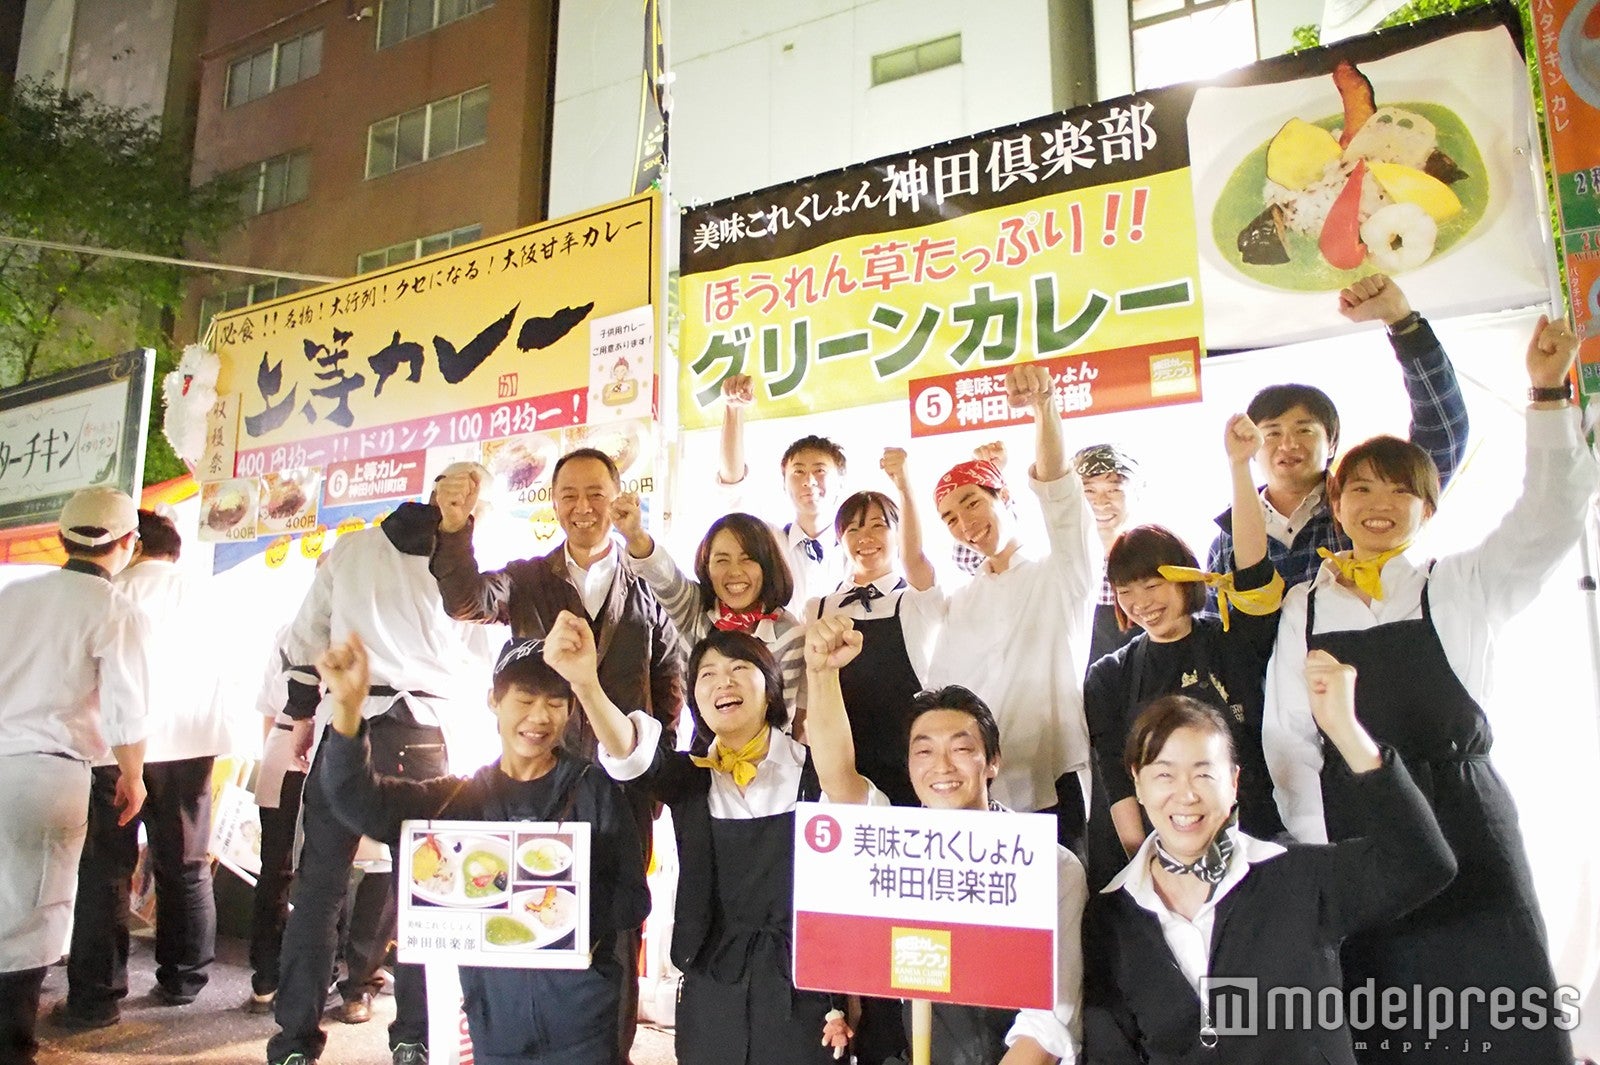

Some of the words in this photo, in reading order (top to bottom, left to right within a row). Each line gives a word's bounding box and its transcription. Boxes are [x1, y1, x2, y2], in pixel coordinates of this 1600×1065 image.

[600, 323, 646, 339] 子供用カレー
[691, 276, 1190, 407] グリーンカレー
[244, 300, 595, 437] 上等カレー
[350, 459, 417, 482] 上等カレー
[518, 487, 553, 503] 400
[286, 514, 316, 529] 400円
[225, 526, 256, 540] 400円
[853, 824, 1034, 866] 美味これくしょん
[869, 863, 1018, 906] 神田倶楽部
[407, 935, 476, 951] 神田倶楽部
